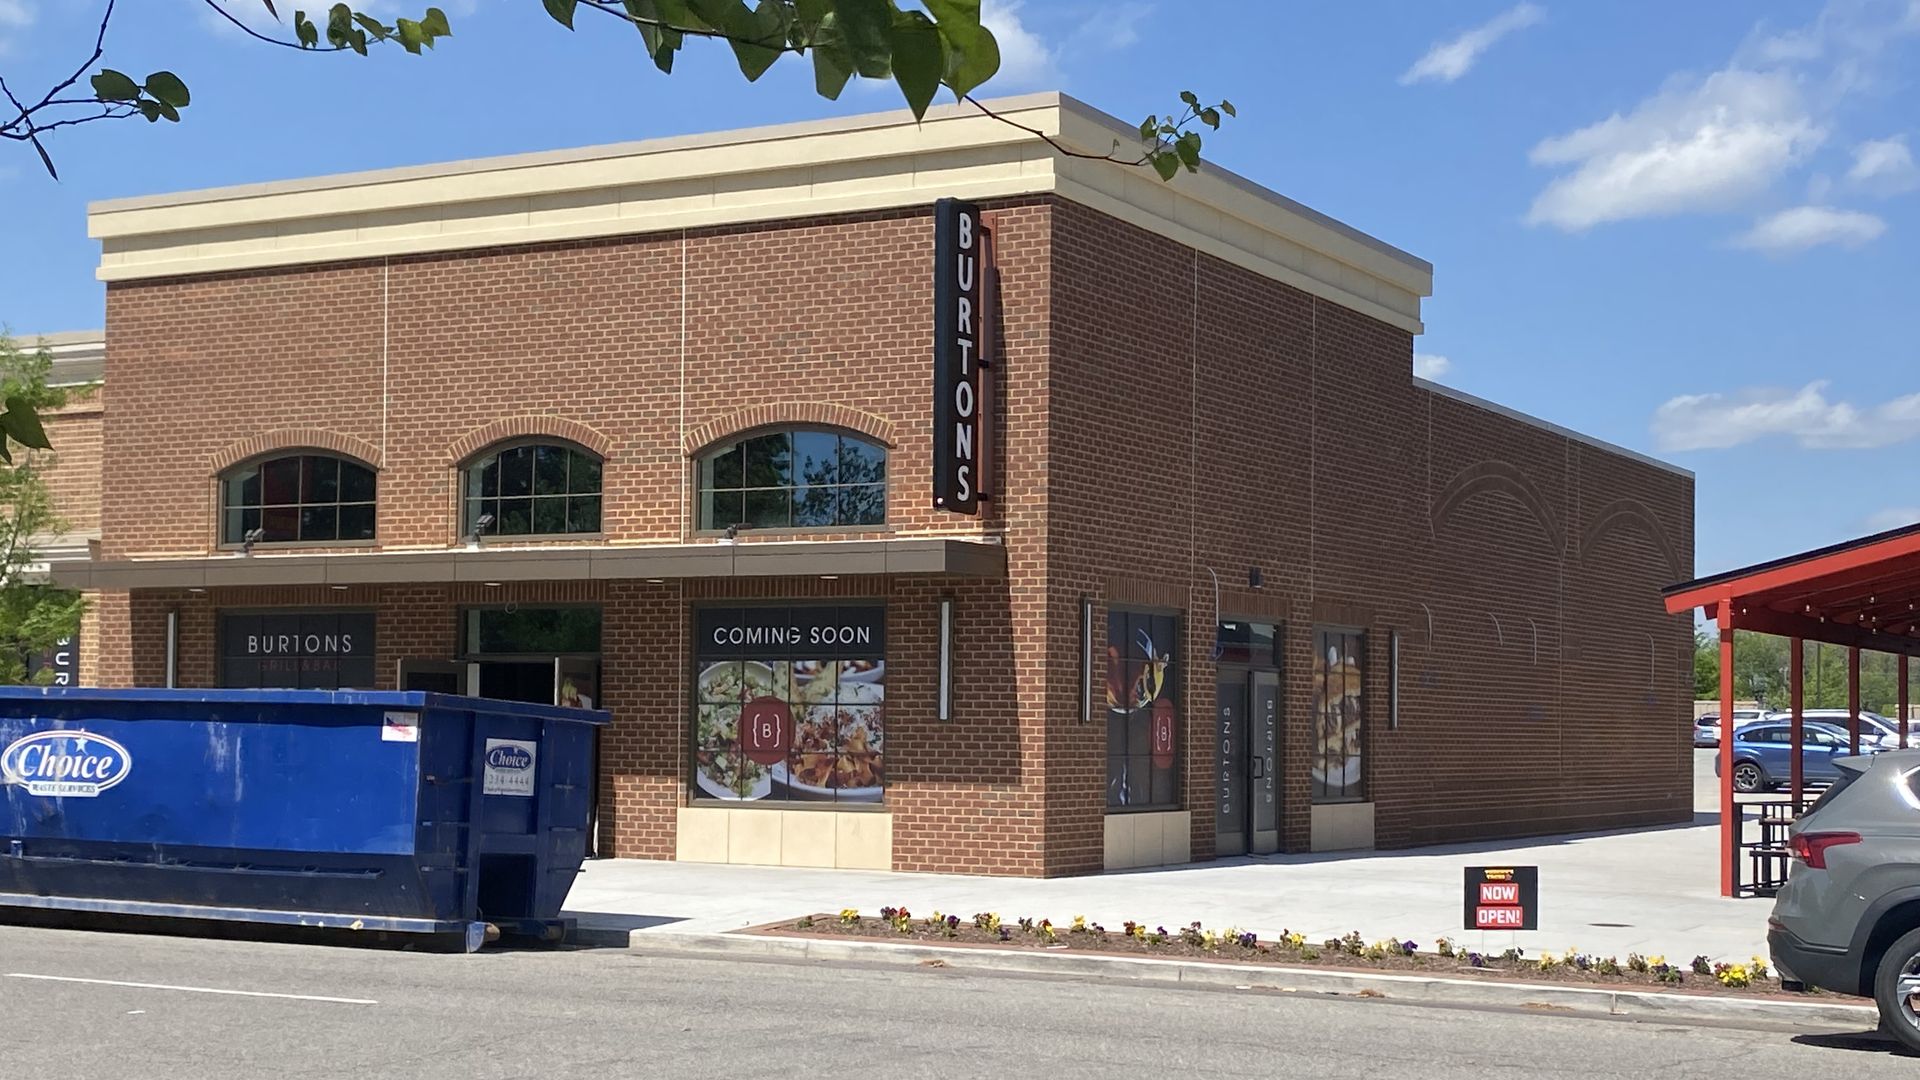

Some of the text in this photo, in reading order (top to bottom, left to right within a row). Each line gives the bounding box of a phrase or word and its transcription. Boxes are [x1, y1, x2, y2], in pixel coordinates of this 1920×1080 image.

[955, 212, 973, 502] BURTONS
[248, 634, 352, 653] BURTONS
[713, 626, 870, 644] COMING SOON
[18, 744, 113, 779] Choice
[490, 749, 528, 767] Choice
[1223, 707, 1231, 814] BURTONS
[58, 784, 95, 793] SERVICES
[1482, 886, 1516, 900] NOW
[1478, 909, 1520, 924] OPEN!
